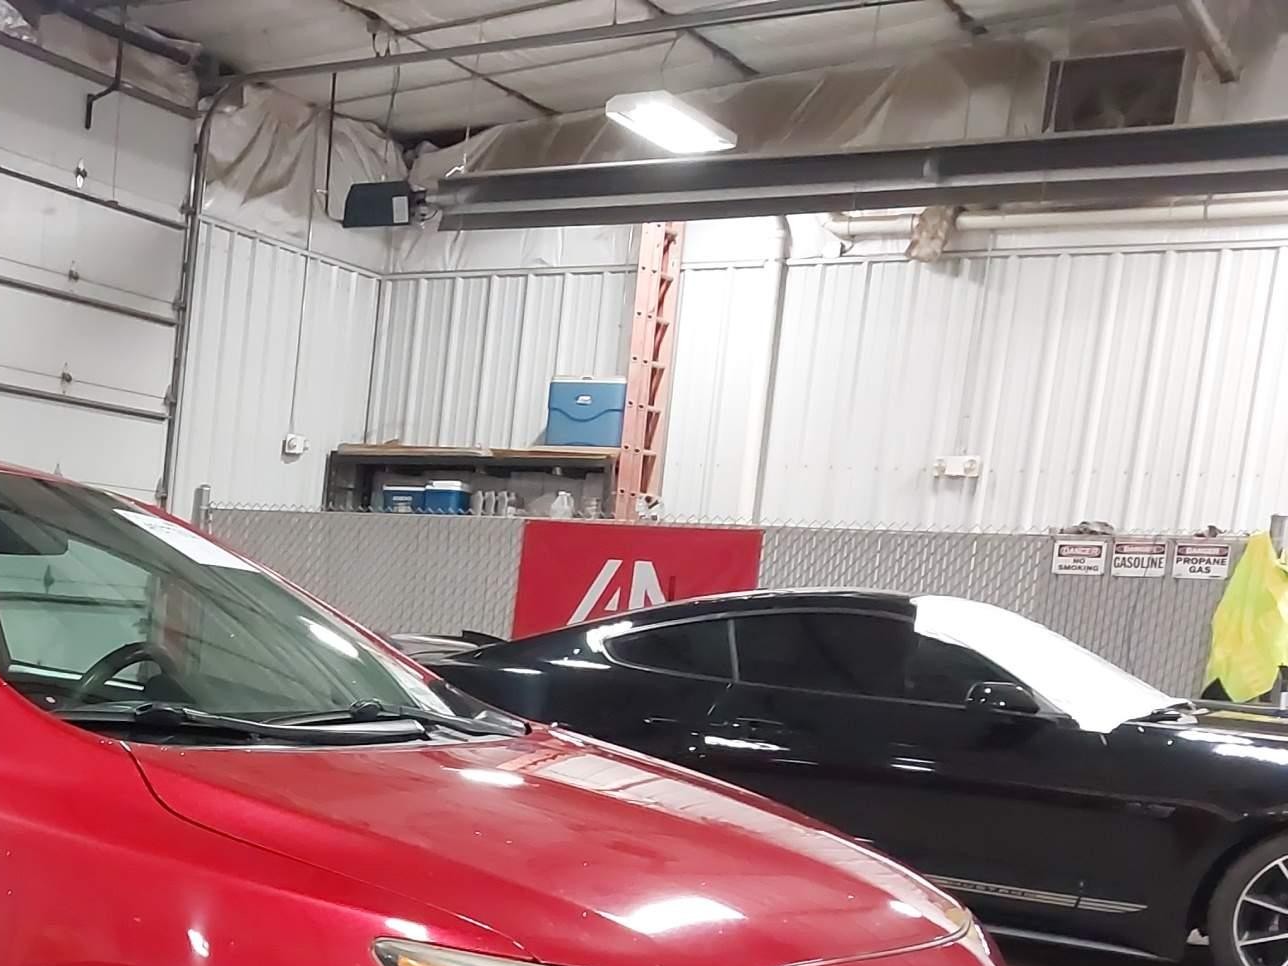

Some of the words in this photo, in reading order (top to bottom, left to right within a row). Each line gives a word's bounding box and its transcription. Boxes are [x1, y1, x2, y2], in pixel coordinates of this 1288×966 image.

[1113, 556, 1164, 569] GASOLINE
[1176, 557, 1227, 566] PROPANE
[1058, 564, 1099, 572] SMOKING
[1188, 565, 1211, 574] GAS
